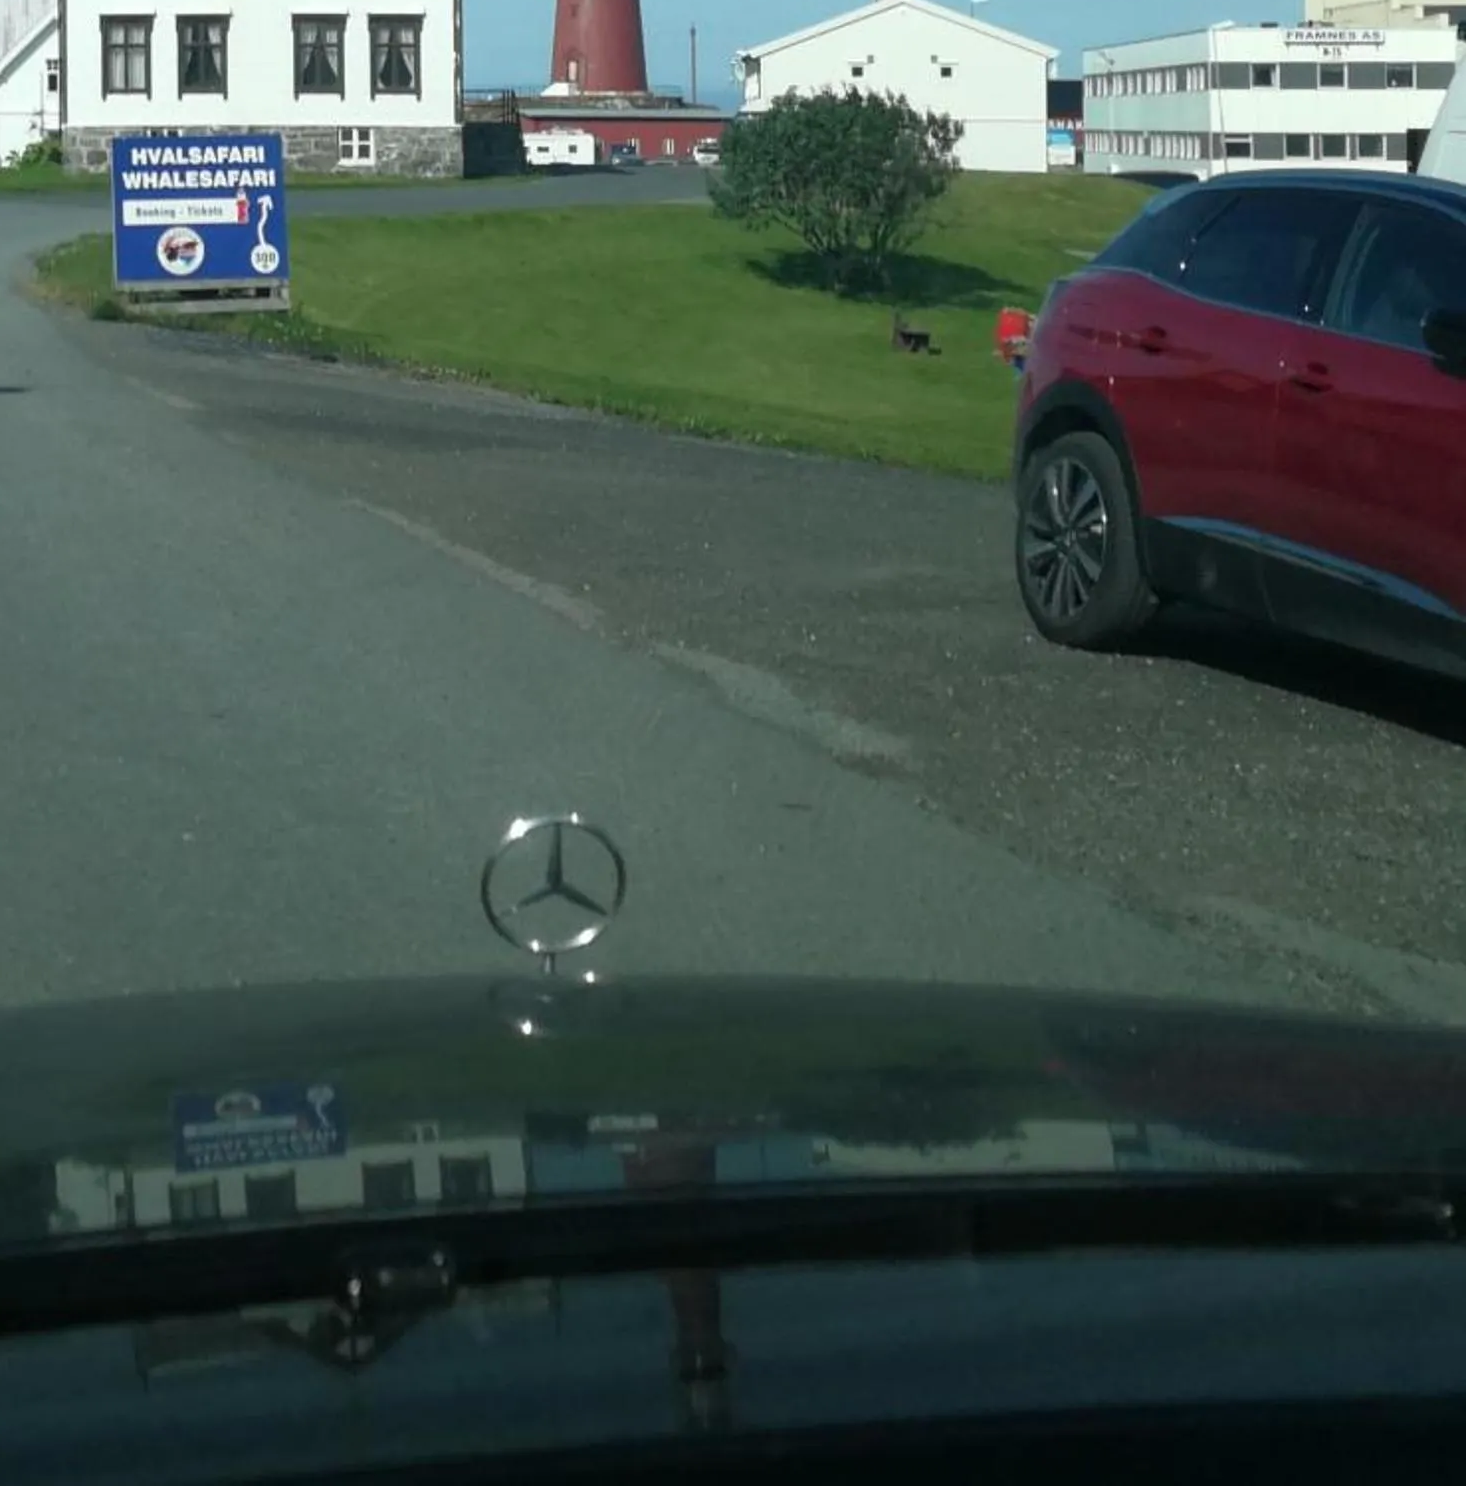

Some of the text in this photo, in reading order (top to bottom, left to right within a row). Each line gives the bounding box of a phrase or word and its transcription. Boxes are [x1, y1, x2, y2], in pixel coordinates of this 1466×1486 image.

[1286, 30, 1381, 40] FRAMNES AS
[131, 145, 265, 165] HVALSAFARI
[122, 168, 277, 190] WHALESAFARI
[136, 206, 176, 219] Booking
[188, 204, 223, 217] Tickets
